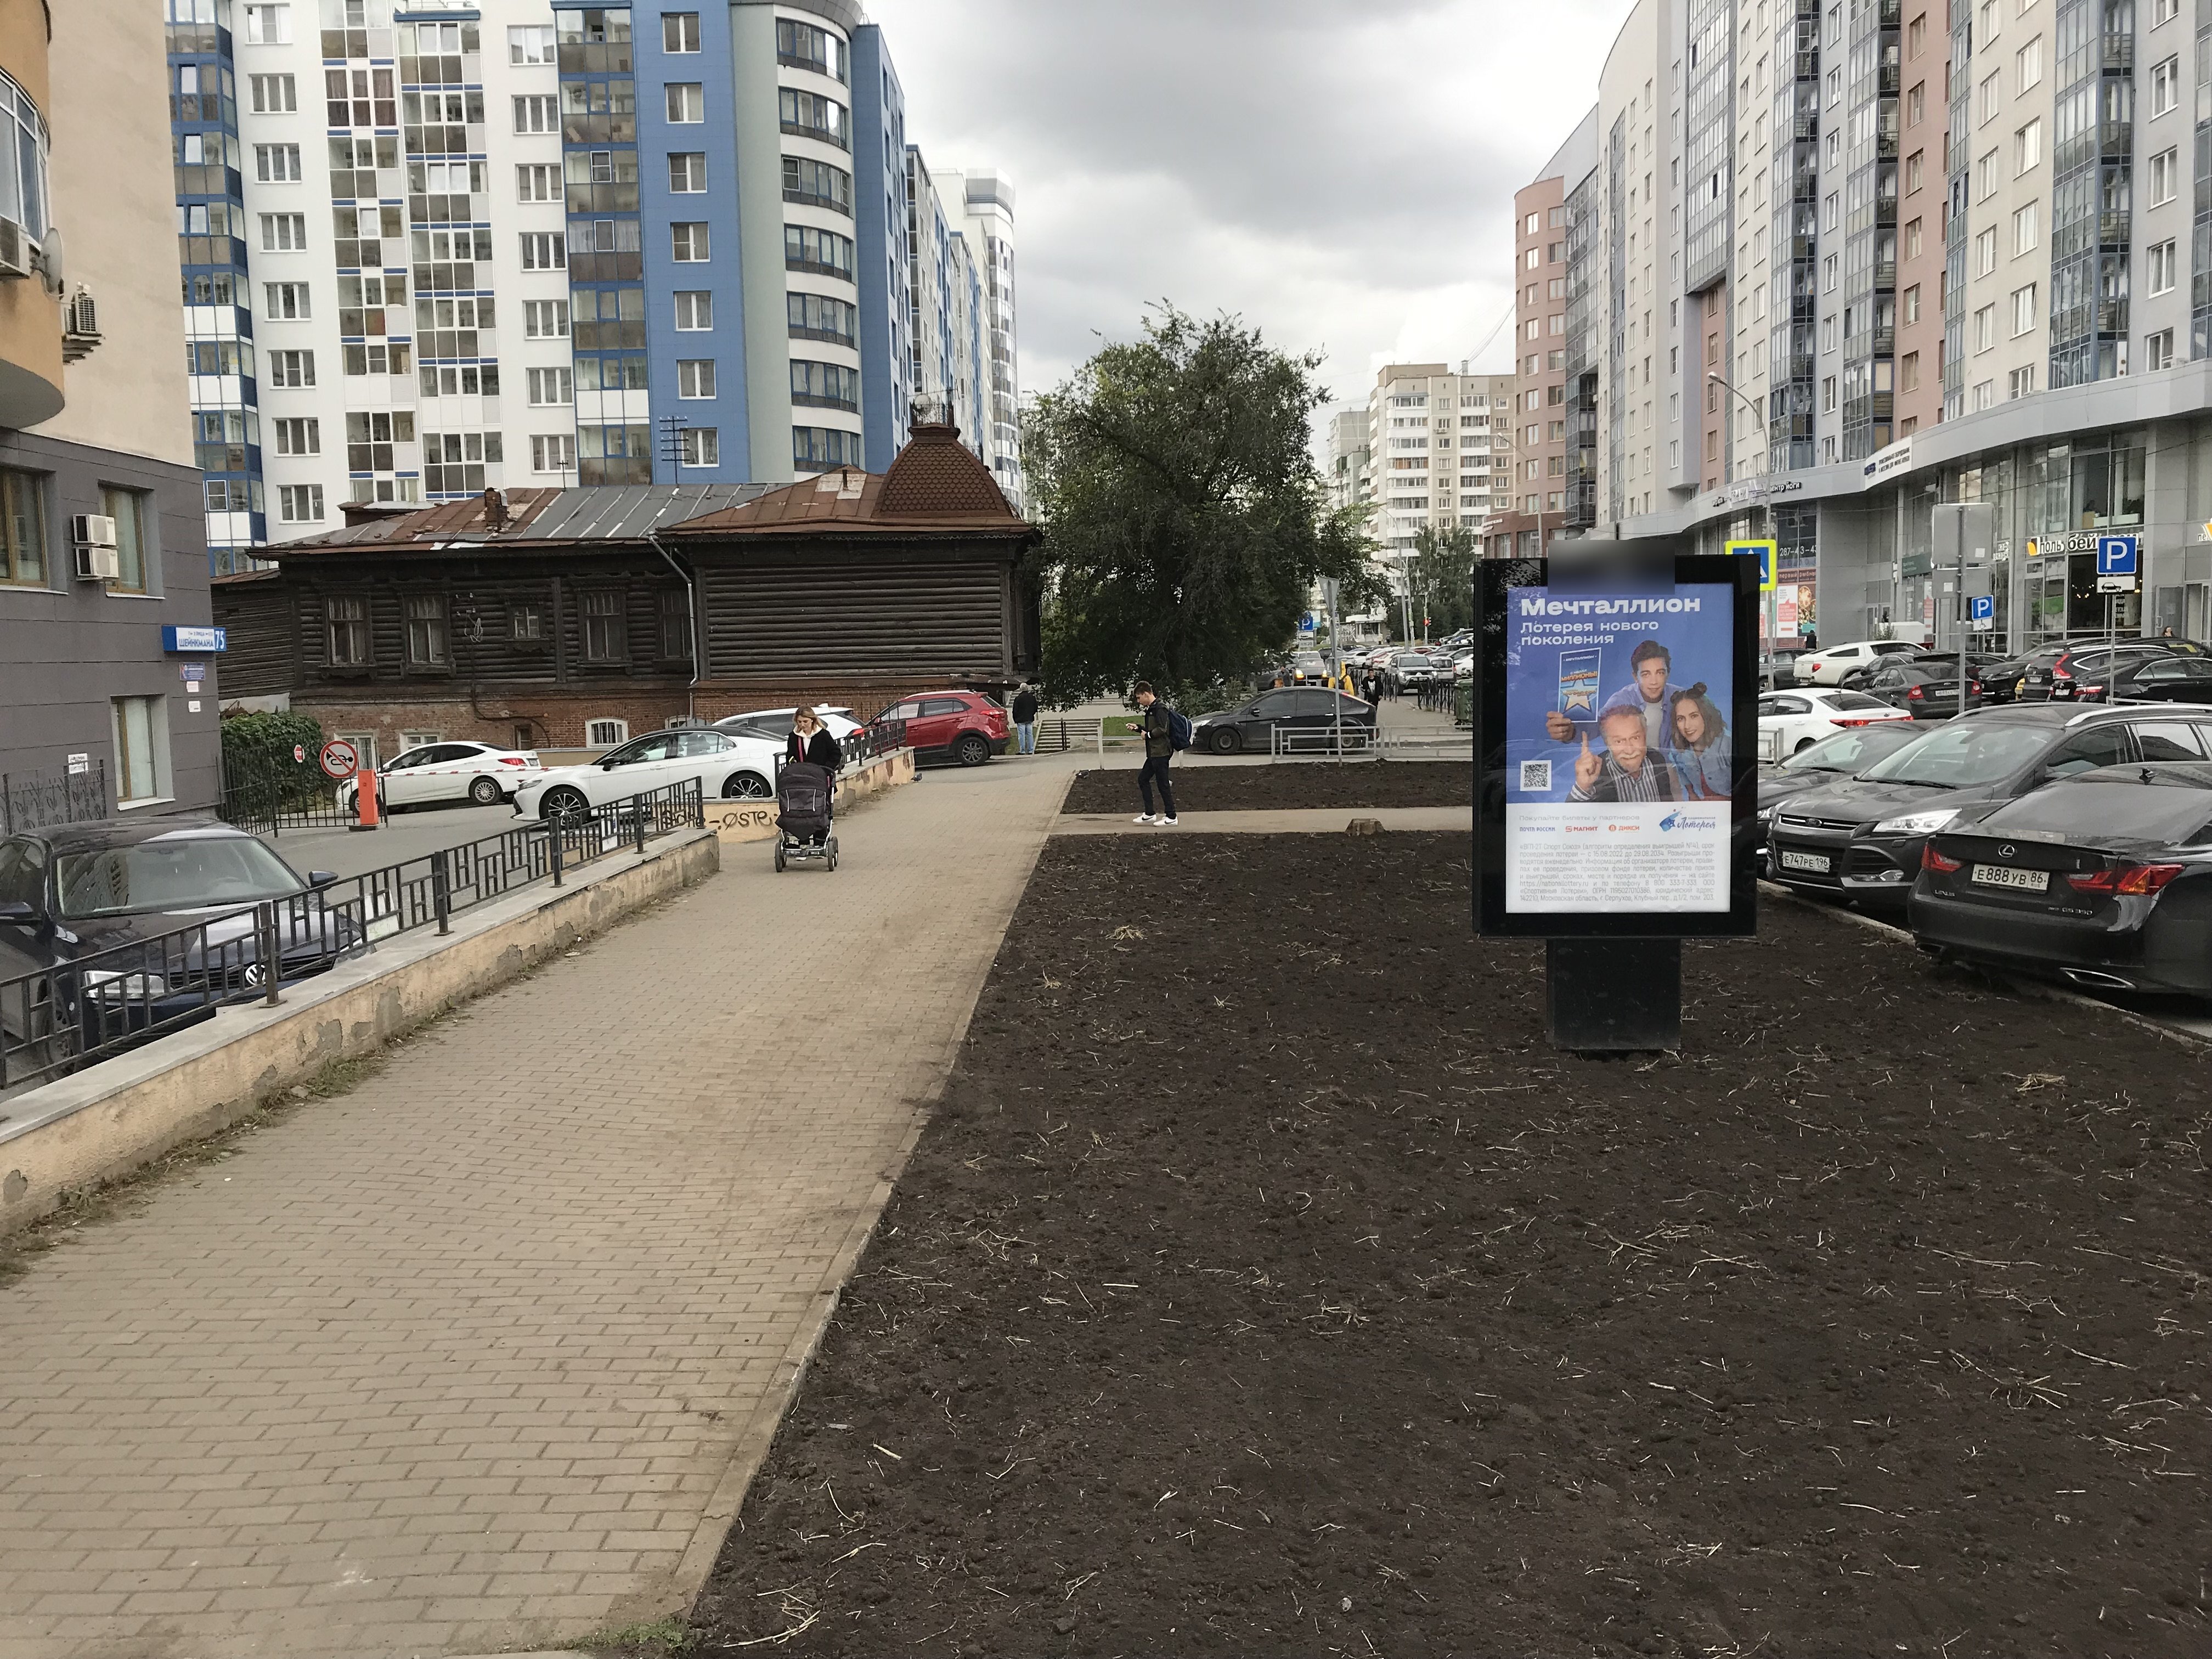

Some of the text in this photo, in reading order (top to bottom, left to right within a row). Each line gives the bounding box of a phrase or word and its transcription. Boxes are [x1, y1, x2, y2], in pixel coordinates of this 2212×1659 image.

[1521, 597, 1701, 616] Мечталлион
[1521, 621, 1659, 634] Лотерея нового
[179, 630, 224, 650] ШЕЙНКМАНА 75
[1521, 635, 1615, 646] поколения
[1677, 817, 1716, 831] Лотерея
[1815, 857, 1828, 866] 196
[2030, 872, 2043, 883] 86
